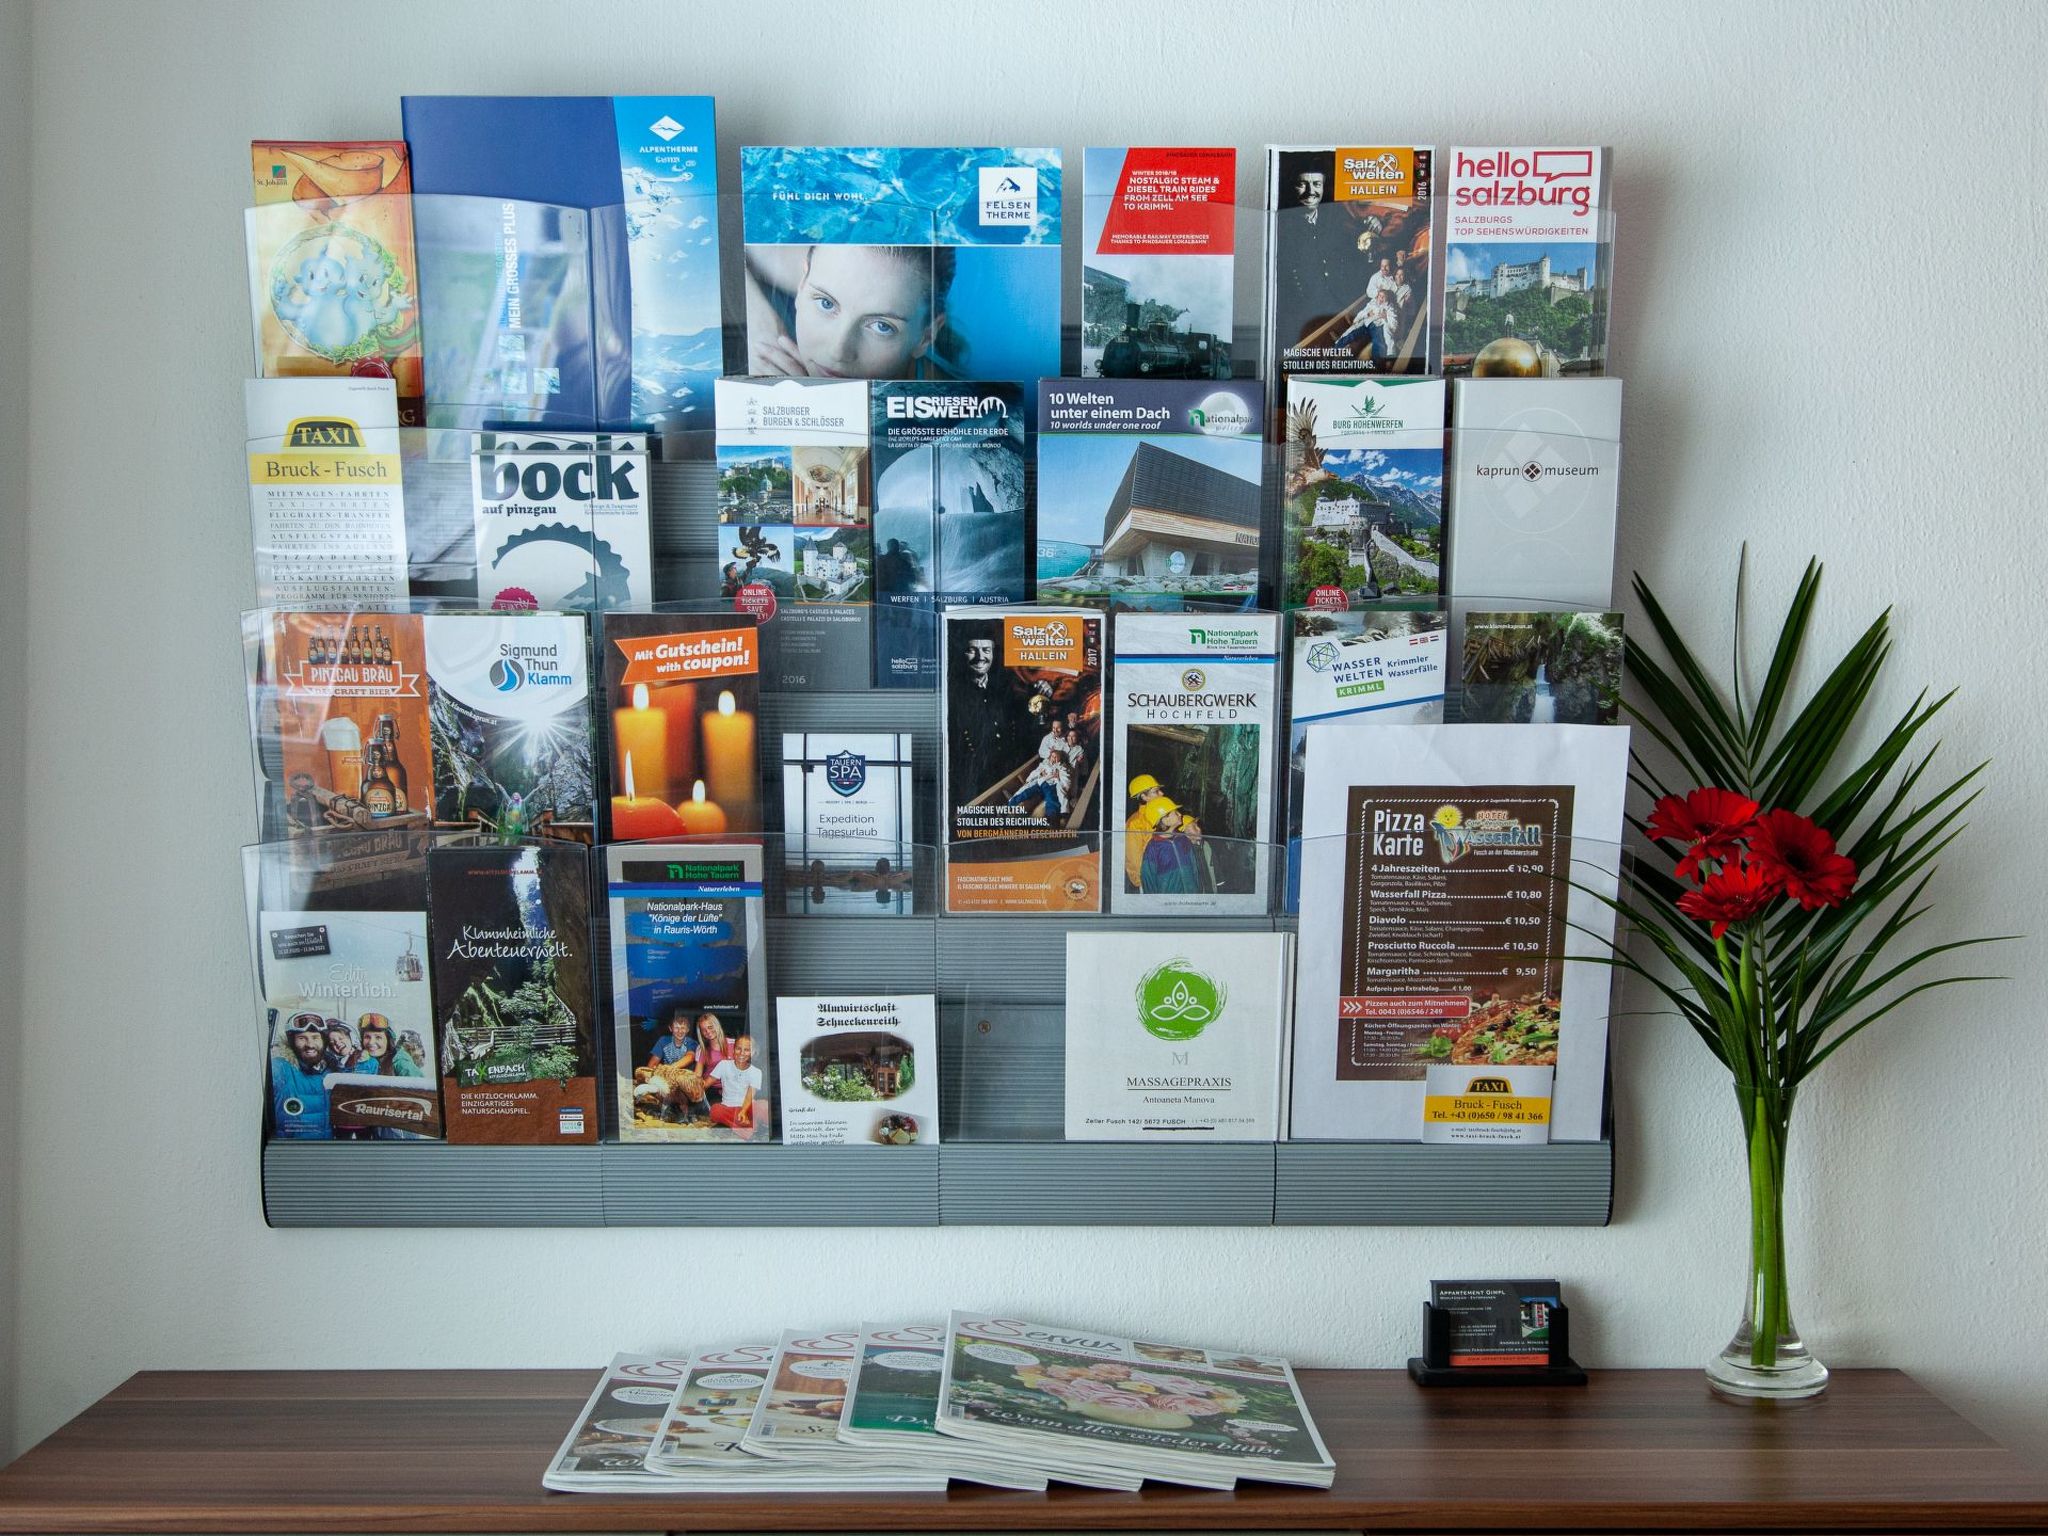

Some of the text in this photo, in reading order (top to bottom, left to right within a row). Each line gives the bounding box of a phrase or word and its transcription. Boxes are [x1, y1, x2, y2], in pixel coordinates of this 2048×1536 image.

[1344, 158, 1376, 169] Salz
[1456, 152, 1530, 178] hello
[1352, 169, 1404, 180] welten
[1350, 186, 1397, 194] HALLEIN
[1417, 181, 1427, 200] 2016
[772, 192, 868, 201] FÜHL DICH WOHL.
[1456, 180, 1590, 216] salzburg
[986, 211, 1031, 219] THERME
[1477, 227, 1588, 235] SEHENSWÜRDIGKEITEN
[503, 202, 521, 329] MEIN GROSSES PLUS
[1283, 348, 1354, 356] MAGISCHE WELTEN.
[1283, 360, 1376, 370] STOLLEN DES REICHTUMS.
[1049, 393, 1114, 405] 10 Welten
[763, 406, 810, 415] SALZBURGER
[887, 396, 978, 418] EIS RIESEN
[932, 406, 979, 418] WELT
[1051, 407, 1170, 419] unter einem Dach
[763, 416, 844, 427] BURGEN & SCHLÖSSER
[1062, 421, 1092, 430] worlds
[1094, 421, 1121, 430] under
[1140, 421, 1161, 430] roof
[1332, 420, 1403, 429] BURG HOHENWERFEN
[297, 428, 352, 444] TAXI
[901, 426, 935, 436] GRÖSSTE
[936, 426, 972, 436] EISHÖHLE
[266, 461, 319, 478] Bruck
[335, 461, 388, 478] Fusch
[1476, 465, 1520, 478] kaprun
[1545, 466, 1598, 476] museum
[480, 455, 639, 501] bock
[482, 504, 557, 516] auf pinzgau
[1013, 626, 1045, 636] Salz
[1022, 636, 1073, 646] welten
[500, 644, 557, 659] Sigmund
[635, 637, 743, 661] Mit Gutschein!
[657, 650, 749, 673] with coupon!
[1020, 652, 1067, 660] HALLEIN
[1088, 648, 1097, 666] 2017
[1387, 655, 1429, 668] Krimmler
[525, 658, 558, 670] Thun
[1332, 657, 1381, 672] WASSER
[312, 665, 392, 682] PINZGAU BRÄU
[1334, 668, 1384, 684] WELTEN
[1388, 664, 1438, 678] Wasserfälle
[528, 673, 572, 685] Klamm
[782, 675, 806, 684] 2016
[1338, 682, 1382, 696] KRIMML
[1128, 693, 1257, 707] SCHAUBERGWERK
[1147, 709, 1237, 719] HOCHFELD
[830, 767, 861, 778] SPA
[957, 806, 1027, 814] MAGISCHE WELTEN.
[819, 814, 875, 825] Expedition
[957, 818, 1050, 826] STOLLEN DES REICHTUMS.
[1374, 809, 1425, 832] Pizza
[816, 827, 878, 838] Tagesurlaub
[1374, 834, 1424, 856] Karte
[1516, 891, 1541, 899] 10,80
[647, 902, 722, 912] Nationalpark-Haus
[648, 913, 722, 923] "Könige der Lüfte"
[1369, 916, 1406, 924] Diavolo
[1514, 916, 1540, 925] 10,50
[463, 925, 556, 940] Klammheimliche
[664, 926, 717, 934] Rauris-Wörth
[447, 938, 573, 959] Abenteuerwelt.
[1368, 941, 1417, 950] Prosciutto
[1419, 942, 1455, 950] Ruccola
[1512, 942, 1538, 951] 10,50
[1367, 967, 1536, 976] Margaritha € 9,50
[299, 981, 395, 997] Winterlich.
[818, 1004, 897, 1013] Almwirtschaft
[817, 1017, 900, 1027] Schneckenreith
[1127, 1077, 1232, 1087] MASSAGEPRAXIS
[1474, 1082, 1505, 1092] TAXI
[355, 1104, 423, 1120] Raurisertal
[961, 1320, 1122, 1352] Servus
